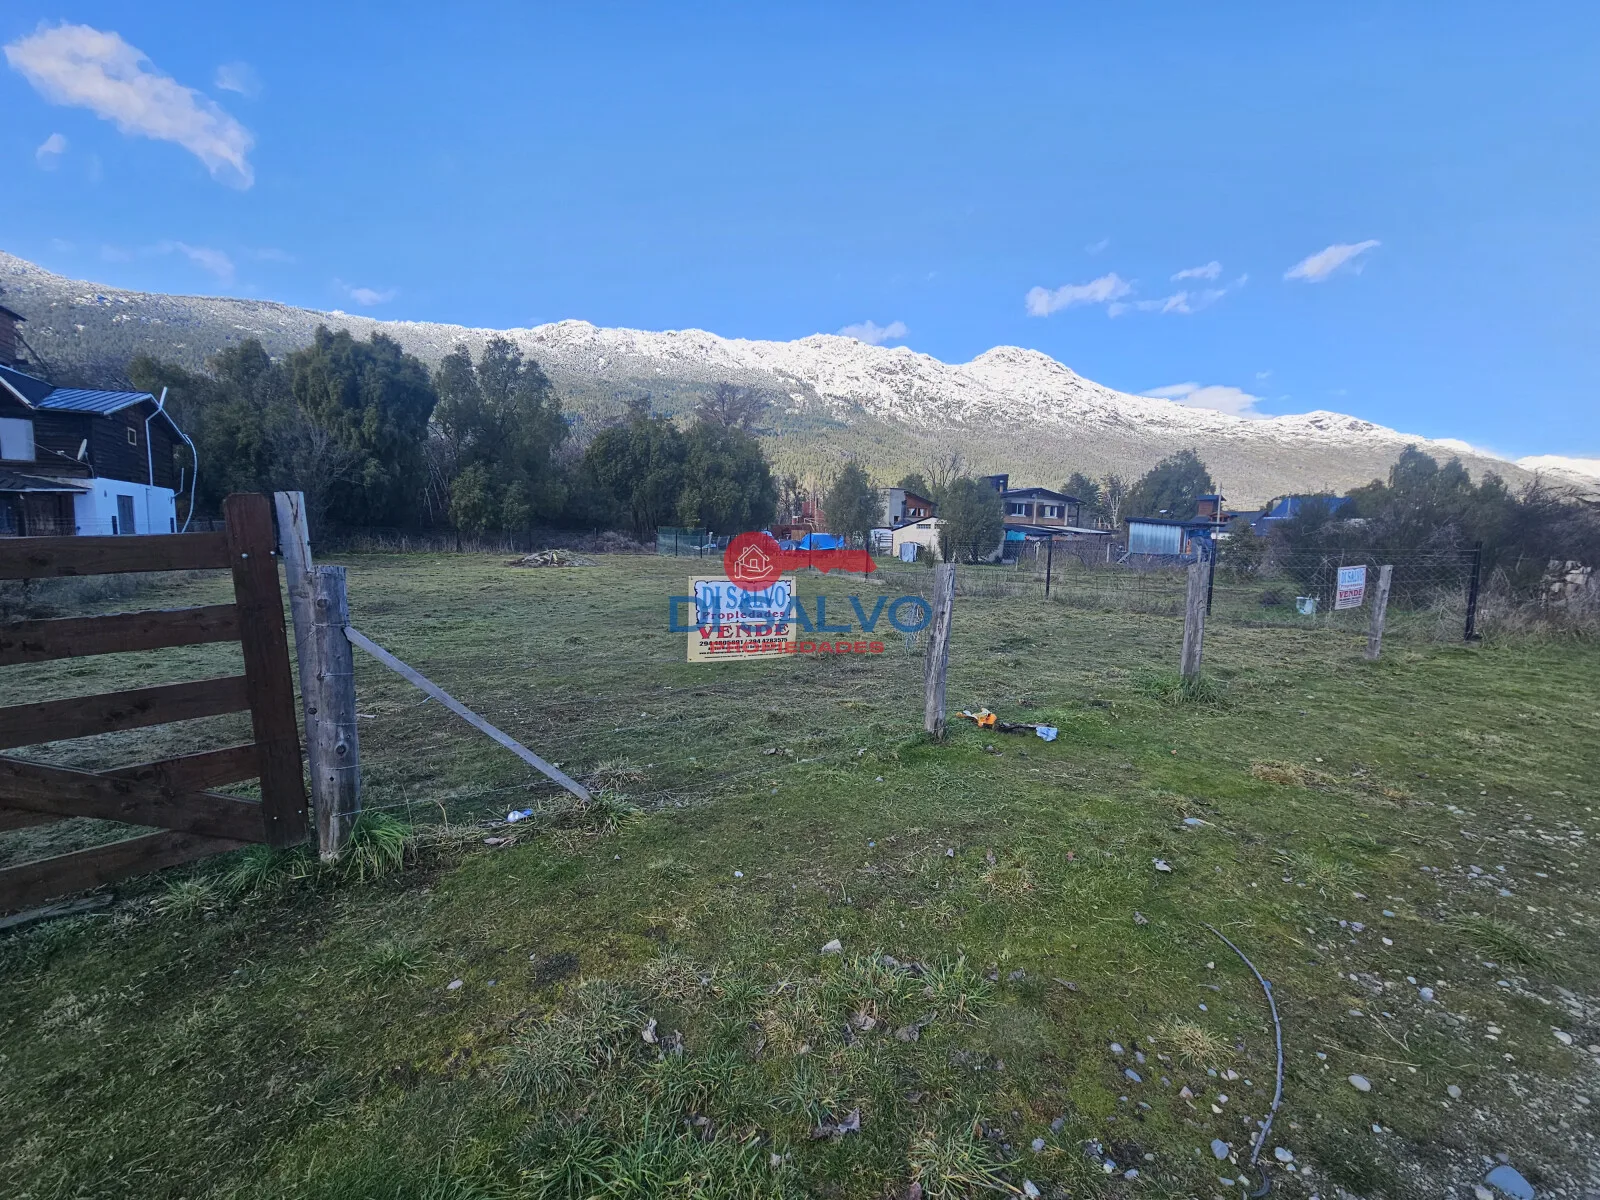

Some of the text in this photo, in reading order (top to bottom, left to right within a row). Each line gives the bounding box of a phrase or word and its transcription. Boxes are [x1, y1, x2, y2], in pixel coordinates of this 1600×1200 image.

[702, 585, 786, 609] DI SALVO
[1339, 589, 1363, 599] VENDE
[702, 610, 786, 621] Propiedades
[698, 623, 790, 640] VENDE
